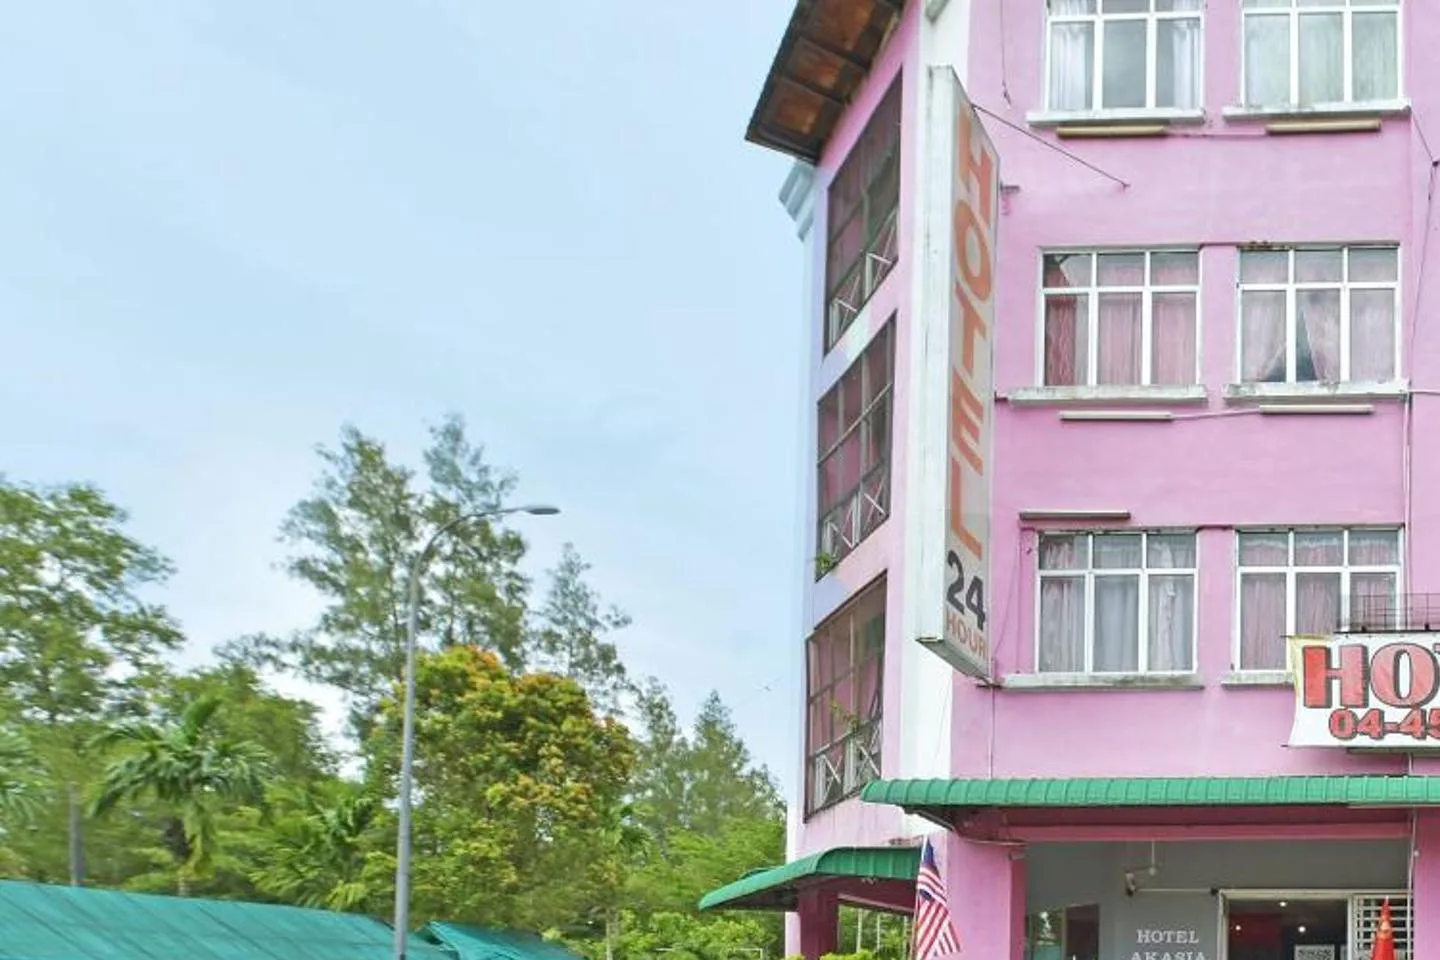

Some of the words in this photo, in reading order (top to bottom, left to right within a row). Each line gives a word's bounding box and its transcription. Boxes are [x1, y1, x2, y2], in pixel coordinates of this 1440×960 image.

[951, 102, 992, 562] HOTEL
[946, 549, 985, 632] 24
[1136, 929, 1199, 944] HOTEL
